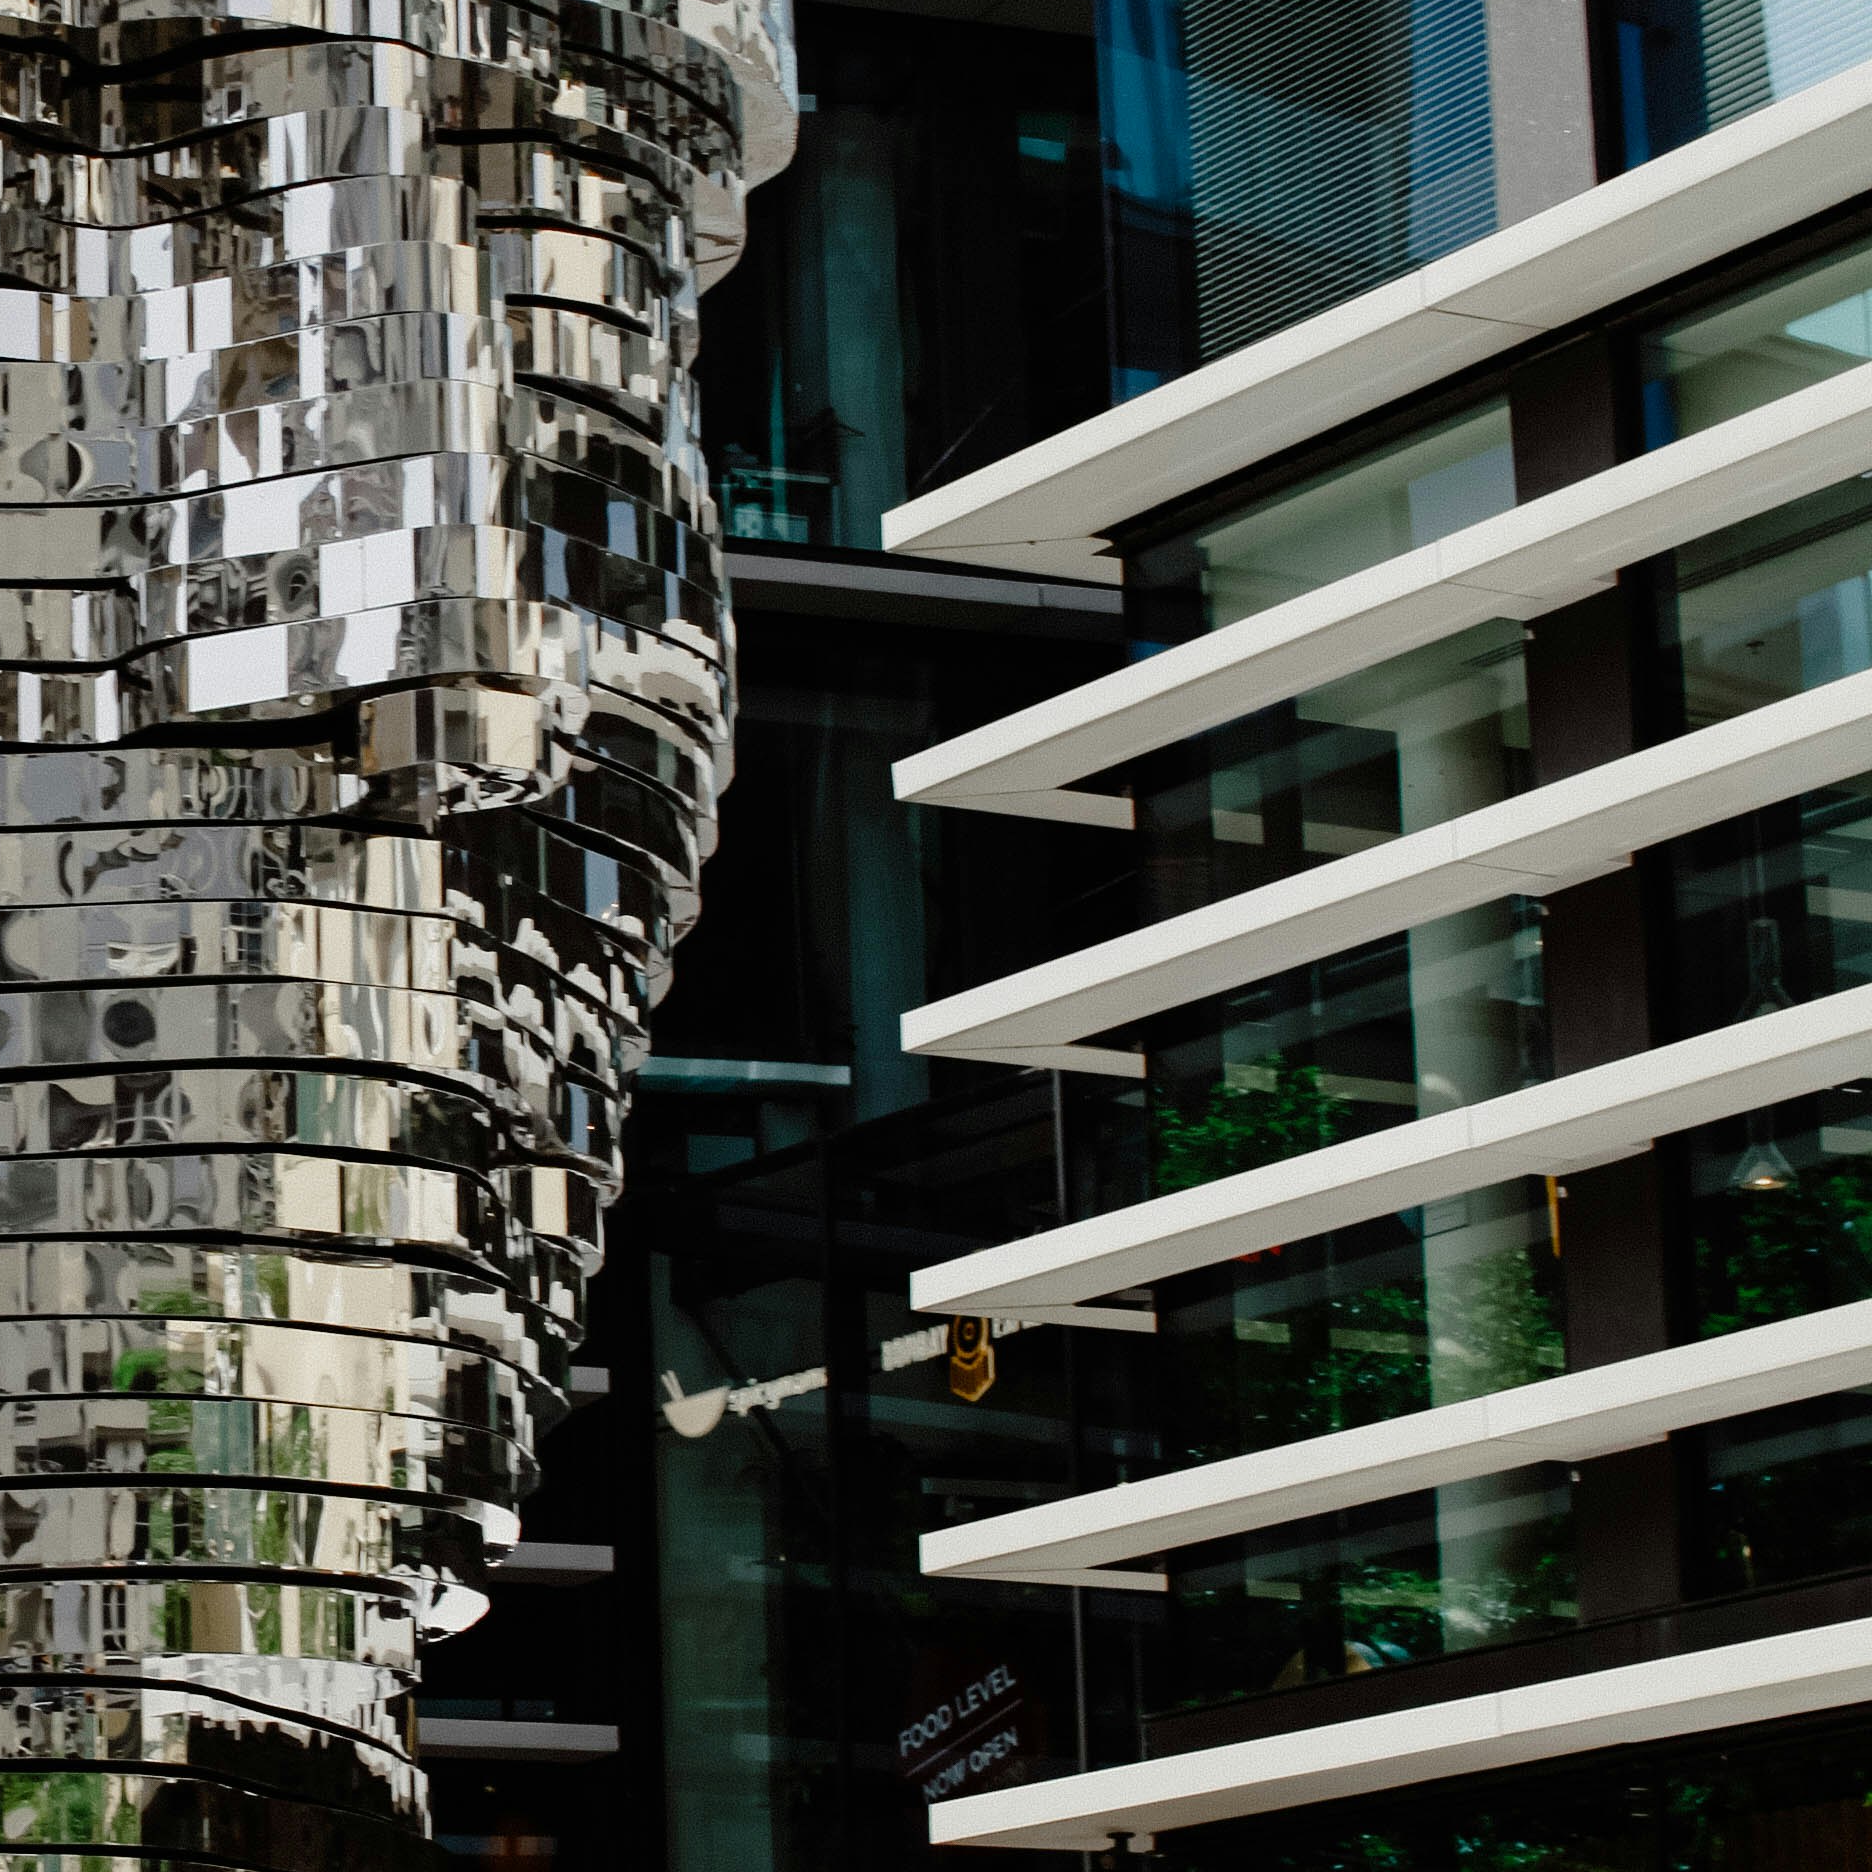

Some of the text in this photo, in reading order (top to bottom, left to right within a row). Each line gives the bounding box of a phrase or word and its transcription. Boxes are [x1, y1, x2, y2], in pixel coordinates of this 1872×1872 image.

[899, 1665, 1017, 1757] FOOD LEVEL
[923, 1726, 1018, 1804] NOW OPEN
